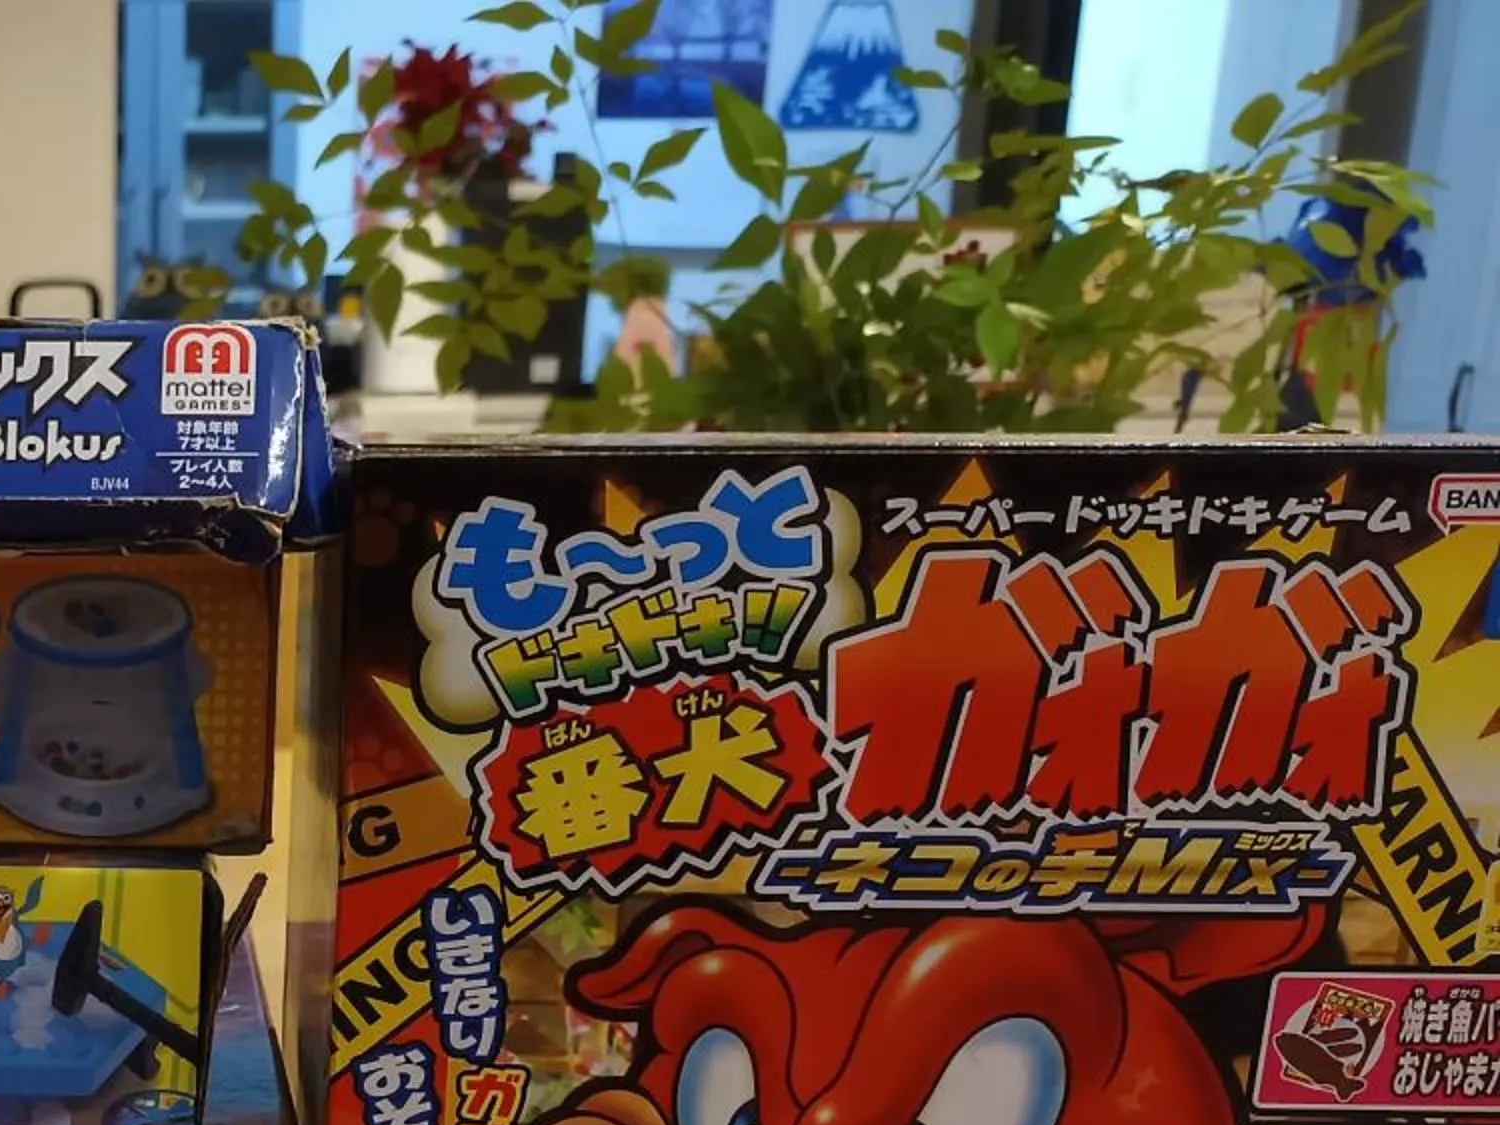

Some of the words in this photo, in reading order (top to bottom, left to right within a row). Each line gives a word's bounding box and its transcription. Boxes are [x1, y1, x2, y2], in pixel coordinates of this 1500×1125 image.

[166, 379, 251, 397] mattel
[176, 420, 239, 435] 対象年齢
[179, 436, 236, 450] 7才以上
[169, 458, 244, 473] プレイ人数
[91, 477, 130, 490] BJV44
[676, 689, 723, 717] けん
[544, 717, 591, 749] ばん
[516, 705, 786, 860] 番犬
[430, 893, 498, 1058] いきなり
